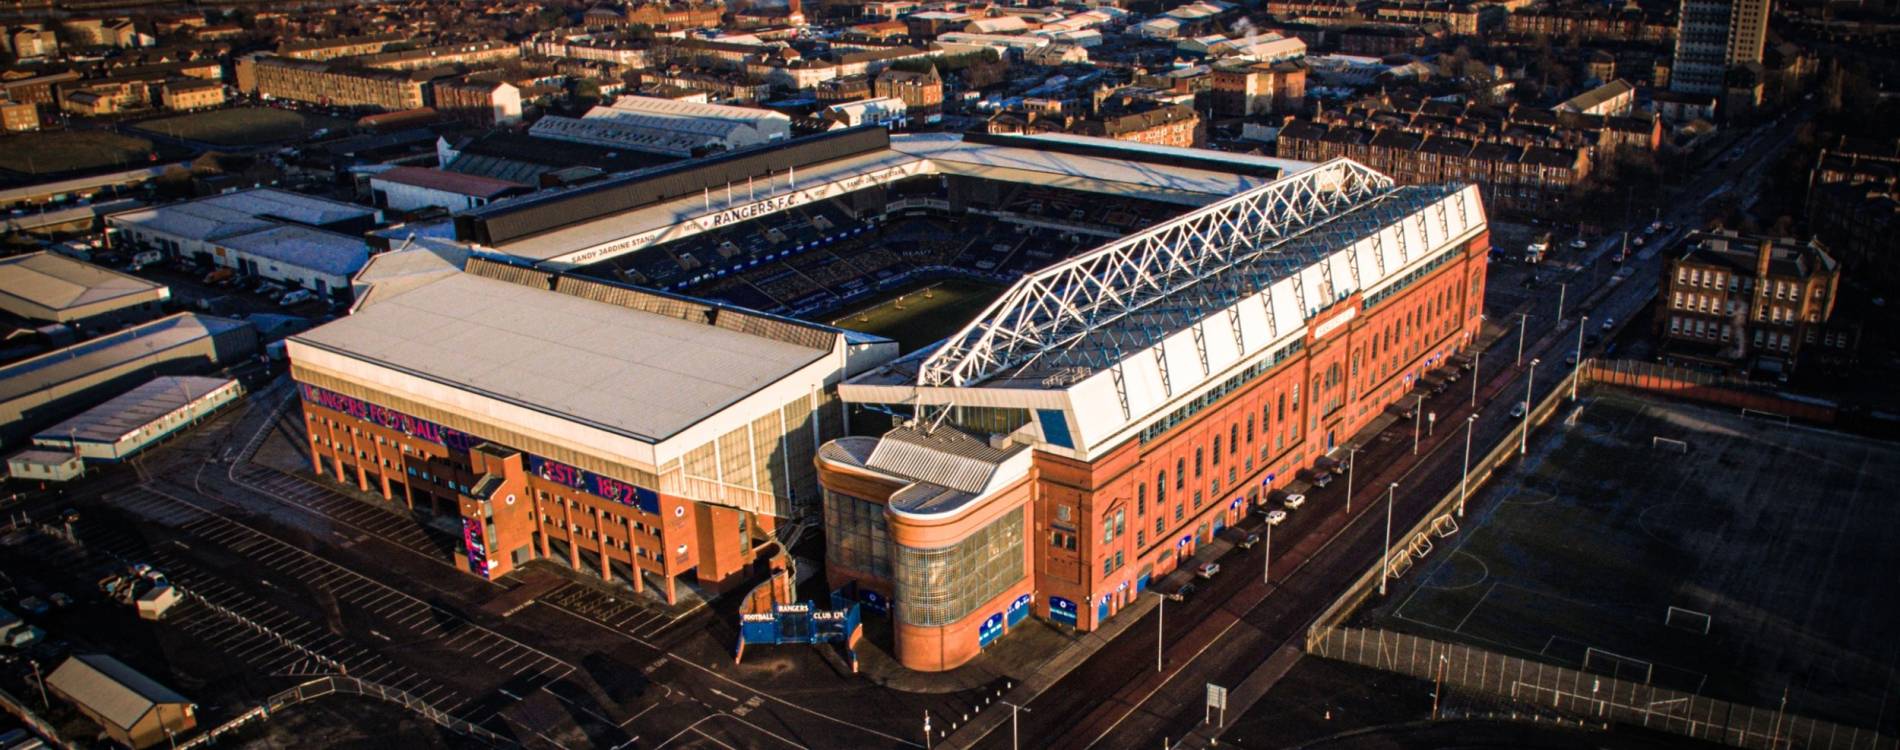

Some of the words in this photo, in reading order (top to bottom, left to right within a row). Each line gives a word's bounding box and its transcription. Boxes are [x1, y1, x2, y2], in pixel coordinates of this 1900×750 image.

[714, 201, 773, 226] RANGERS
[778, 195, 799, 209] F.C.
[571, 251, 596, 263] SANDY
[599, 242, 629, 256] JARDINE
[632, 235, 656, 246] STAND
[743, 613, 775, 621] FOOTBALL
[813, 611, 831, 620] CLUB
[778, 604, 808, 613] RANGERS
